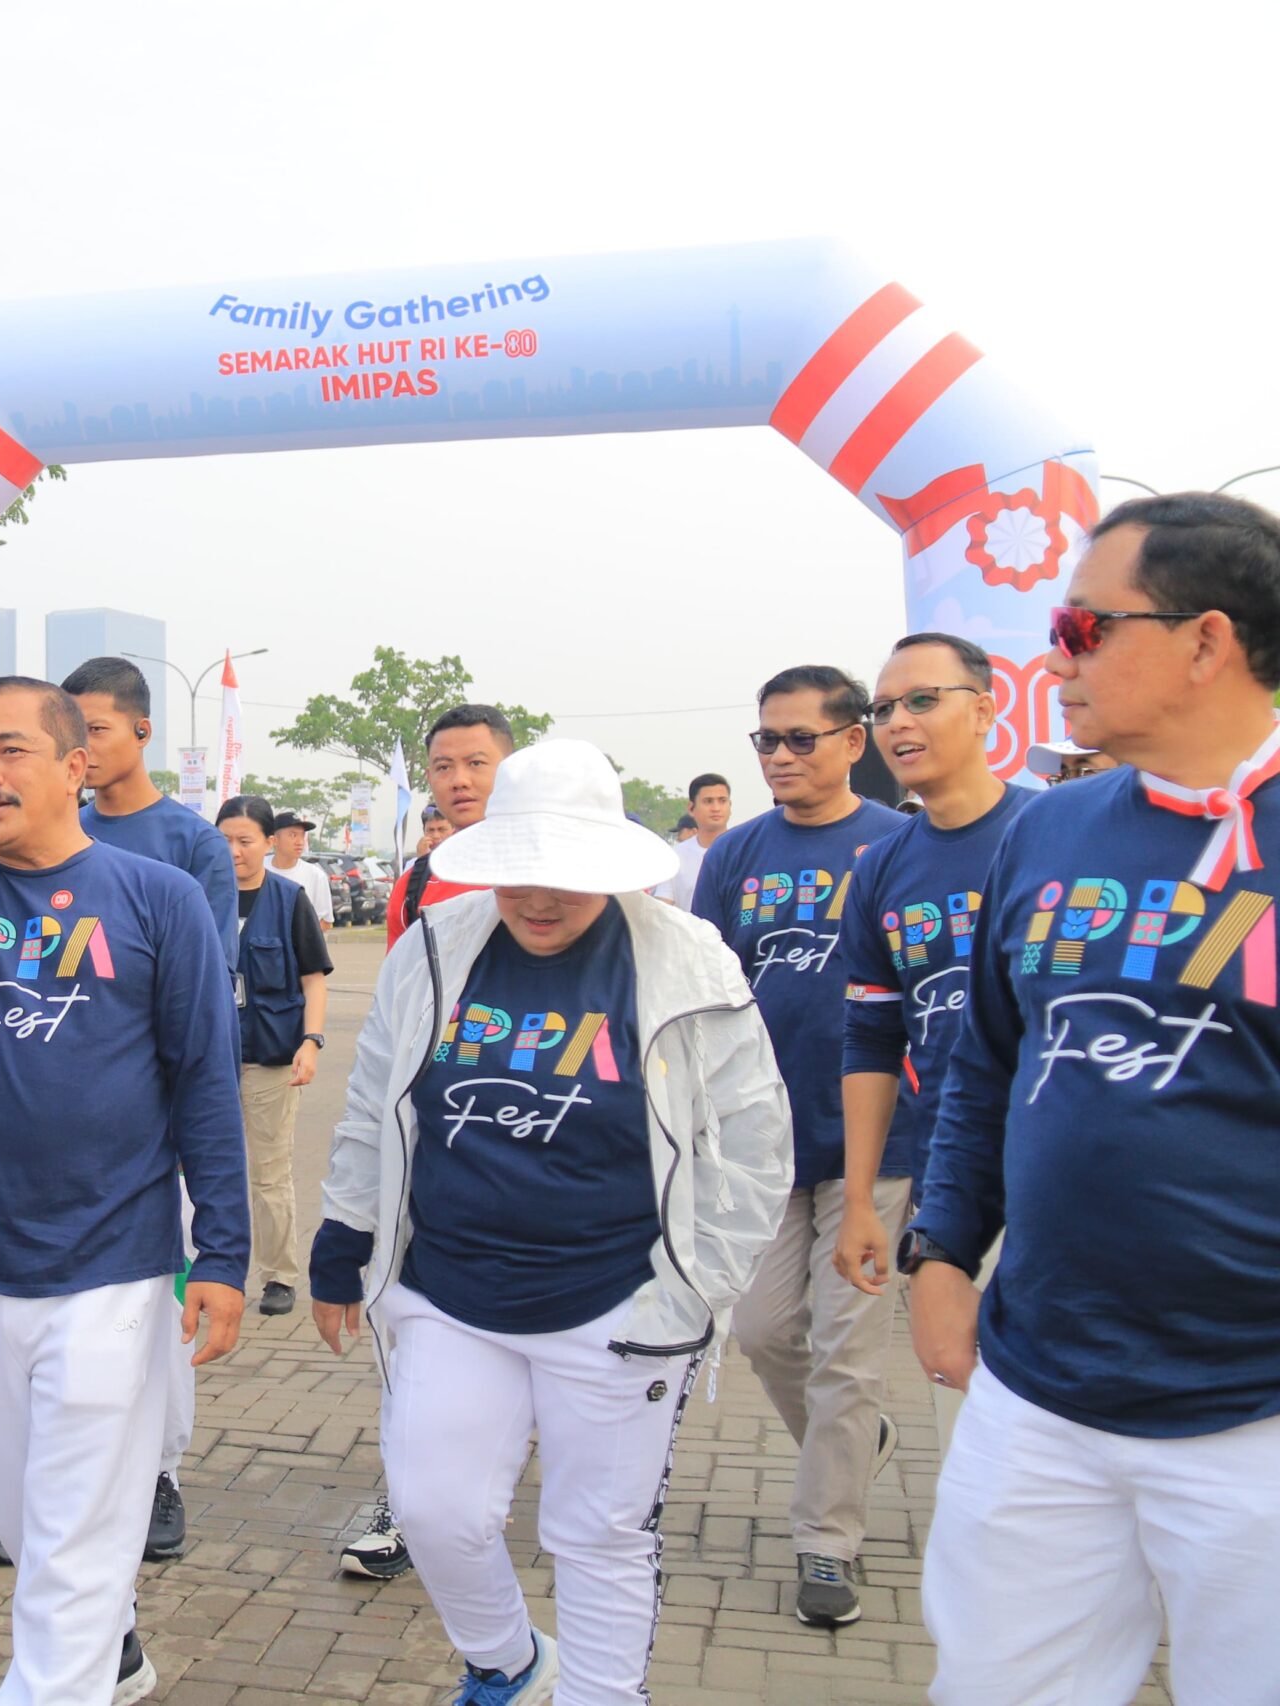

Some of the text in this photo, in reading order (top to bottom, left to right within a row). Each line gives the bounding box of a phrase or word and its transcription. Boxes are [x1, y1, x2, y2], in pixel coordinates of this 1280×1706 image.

[209, 274, 550, 338] Family Gathering
[218, 329, 537, 376] SEMARAK HUT RI KE-80
[321, 369, 439, 402] IMIPAS
[1027, 992, 1233, 1104] Fest
[443, 1077, 592, 1149] Fest
